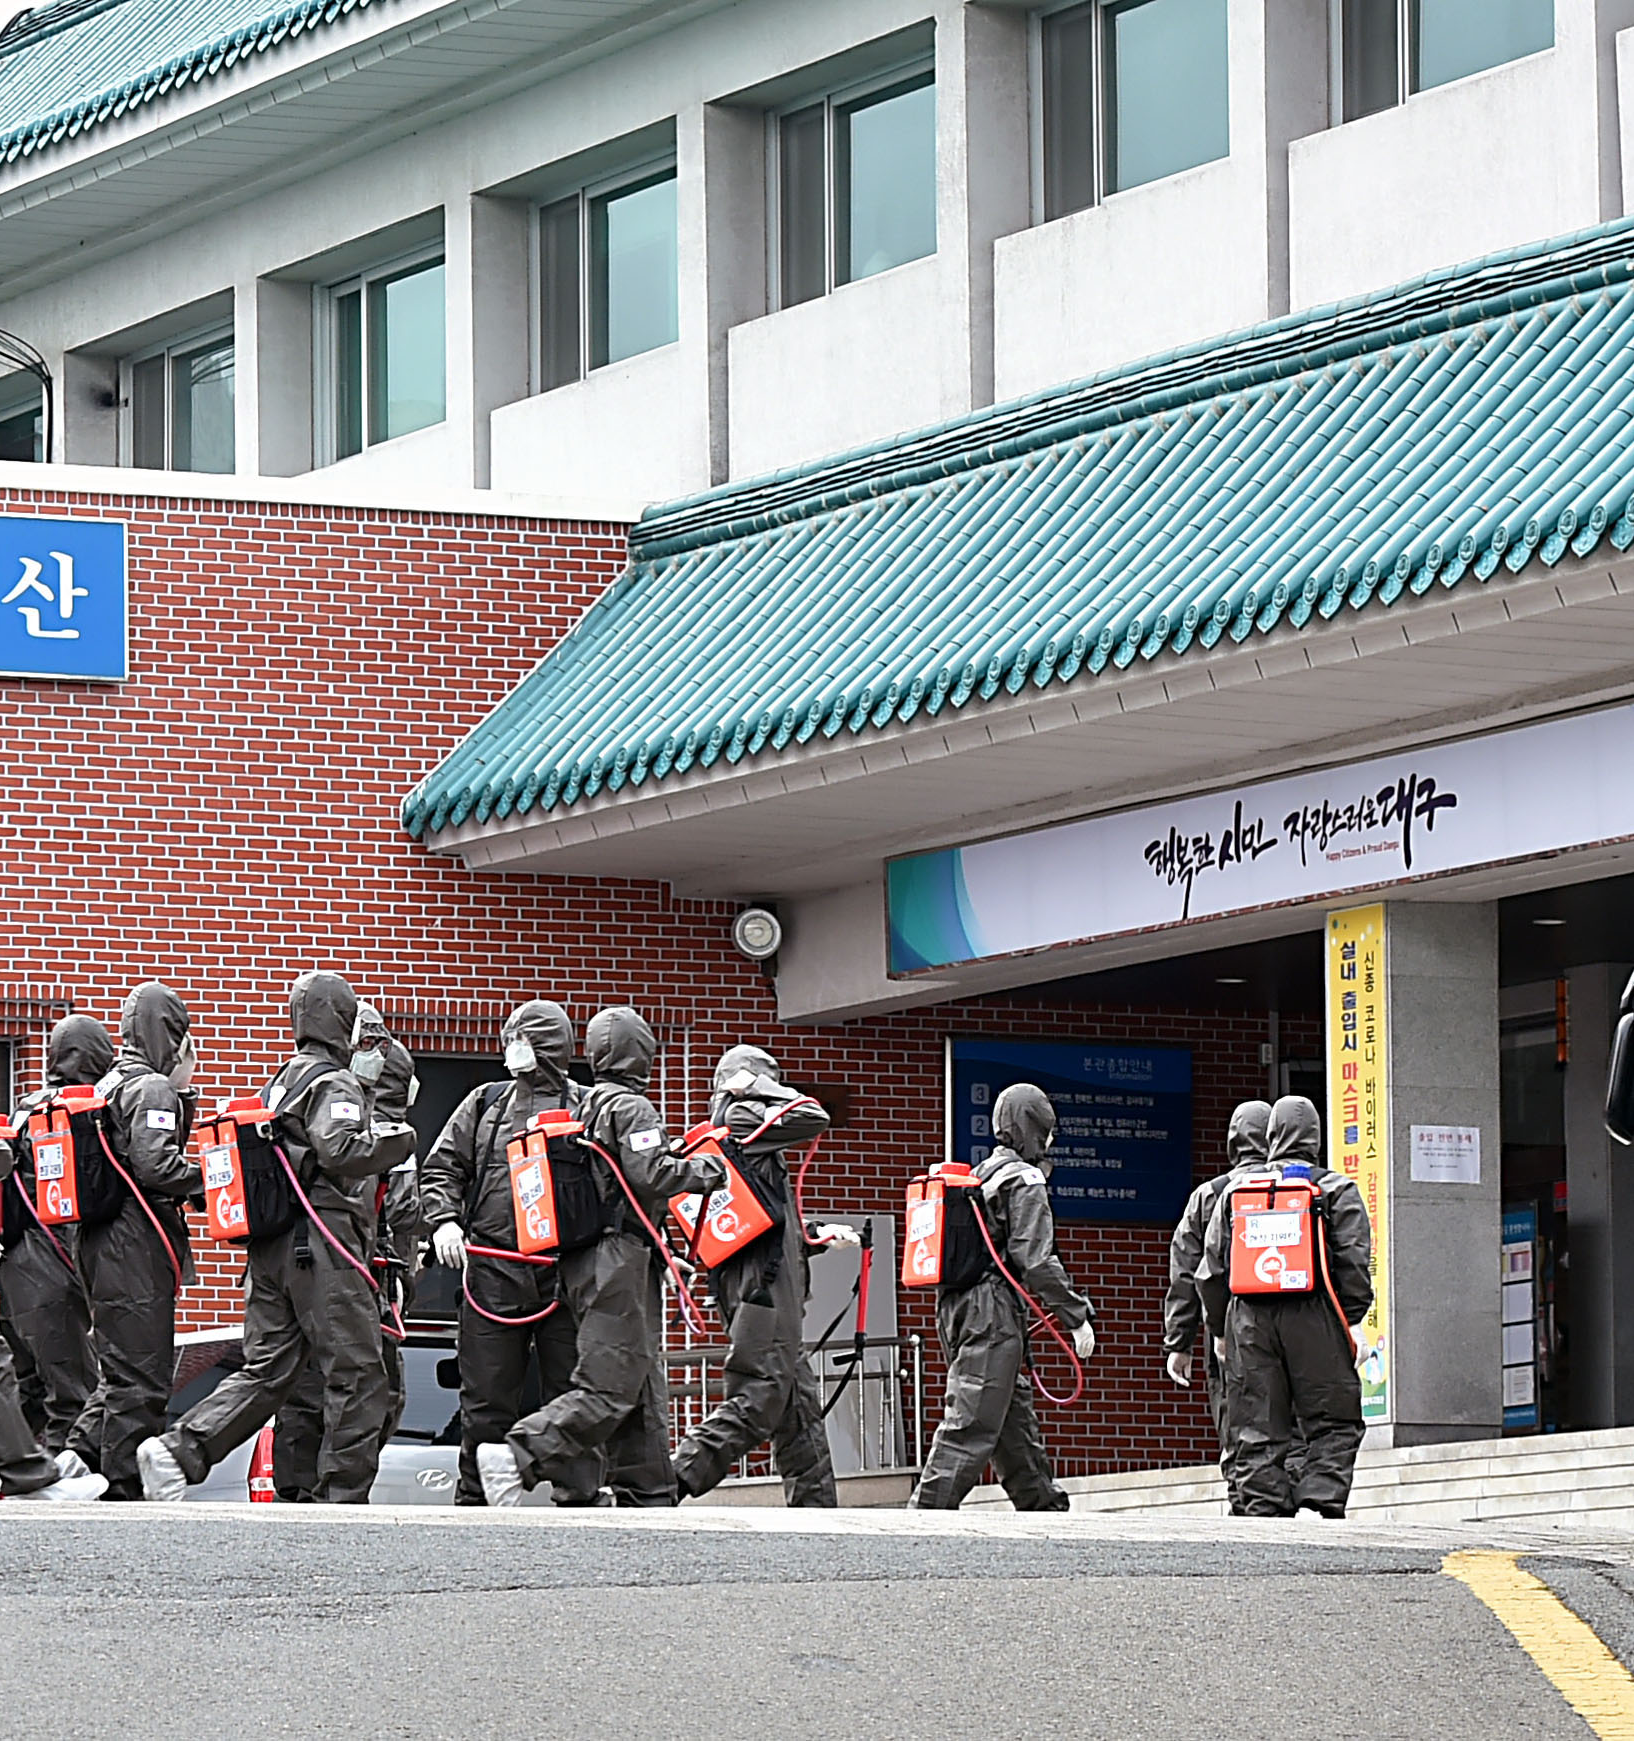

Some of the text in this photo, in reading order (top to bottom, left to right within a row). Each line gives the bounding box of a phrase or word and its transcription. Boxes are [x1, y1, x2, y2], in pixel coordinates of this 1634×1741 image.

[1144, 772, 1458, 919] 행복한 시민 자랑스러운 대구
[1340, 940, 1357, 981] 실내
[1364, 950, 1375, 993] 신종
[1341, 990, 1359, 1052] 출입시
[1364, 1005, 1376, 1065] 코로나
[976, 1086, 985, 1102] 3
[1342, 1062, 1359, 1145] 마스크를
[1365, 1076, 1377, 1159] 바이러스
[976, 1118, 985, 1133] 2
